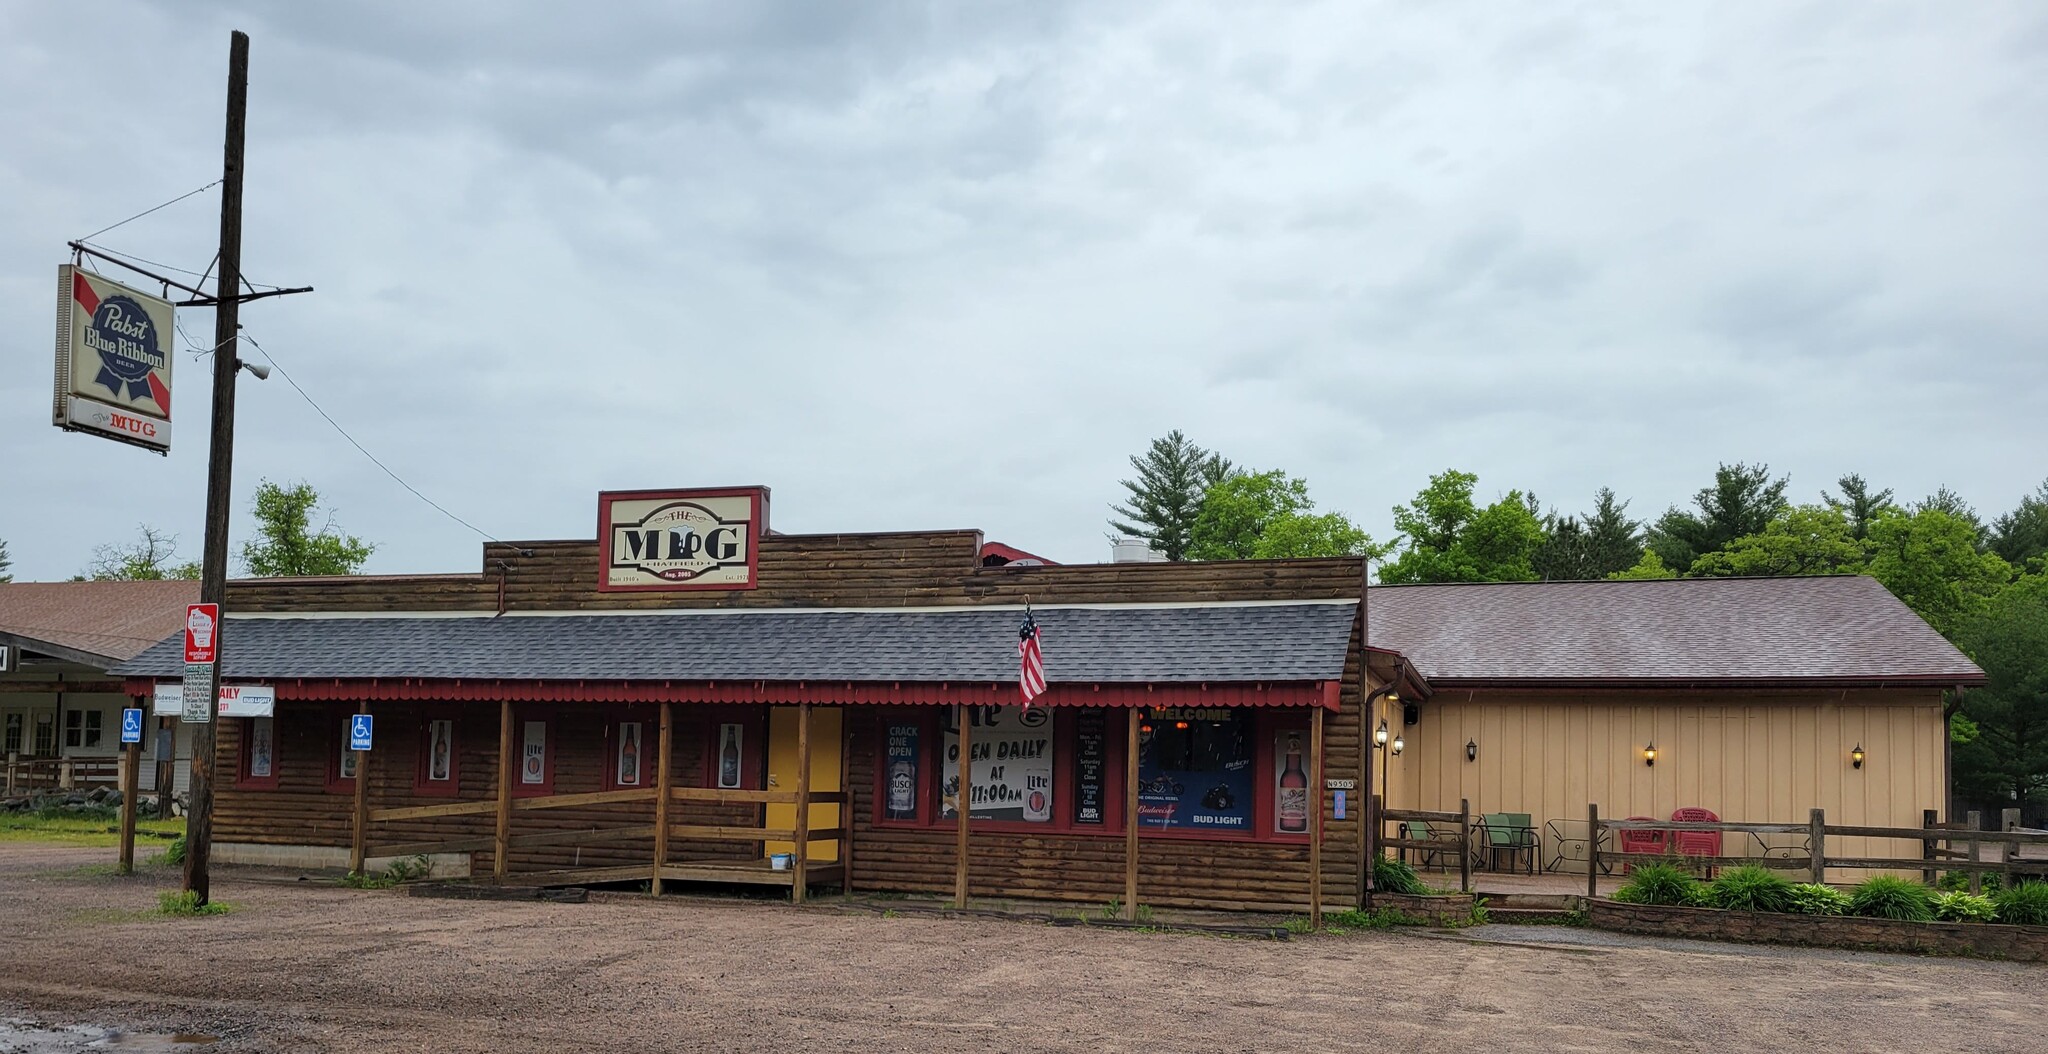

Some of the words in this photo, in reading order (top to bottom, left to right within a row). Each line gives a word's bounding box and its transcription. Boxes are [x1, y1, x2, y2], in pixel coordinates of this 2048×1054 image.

[104, 303, 148, 340] Pabst
[86, 326, 116, 354] Blue
[117, 336, 164, 369] Ribbon
[110, 412, 156, 438] MUG
[668, 510, 693, 521] THE
[154, 693, 181, 701] Budweiser
[218, 687, 240, 699] AILY
[1150, 708, 1232, 721] WELCOME
[889, 726, 918, 737] CRACK
[889, 737, 907, 747] ONE
[527, 744, 543, 757] Lite
[889, 747, 912, 757] OPEN
[948, 741, 991, 763] OEN
[997, 738, 1048, 761] DAILY
[990, 765, 1005, 781] AT
[1027, 775, 1048, 791] Lite
[1328, 780, 1353, 788] N9505
[1137, 805, 1175, 814] Budweiser
[1193, 815, 1213, 824] BUD
[1215, 816, 1243, 825] LIGHT
